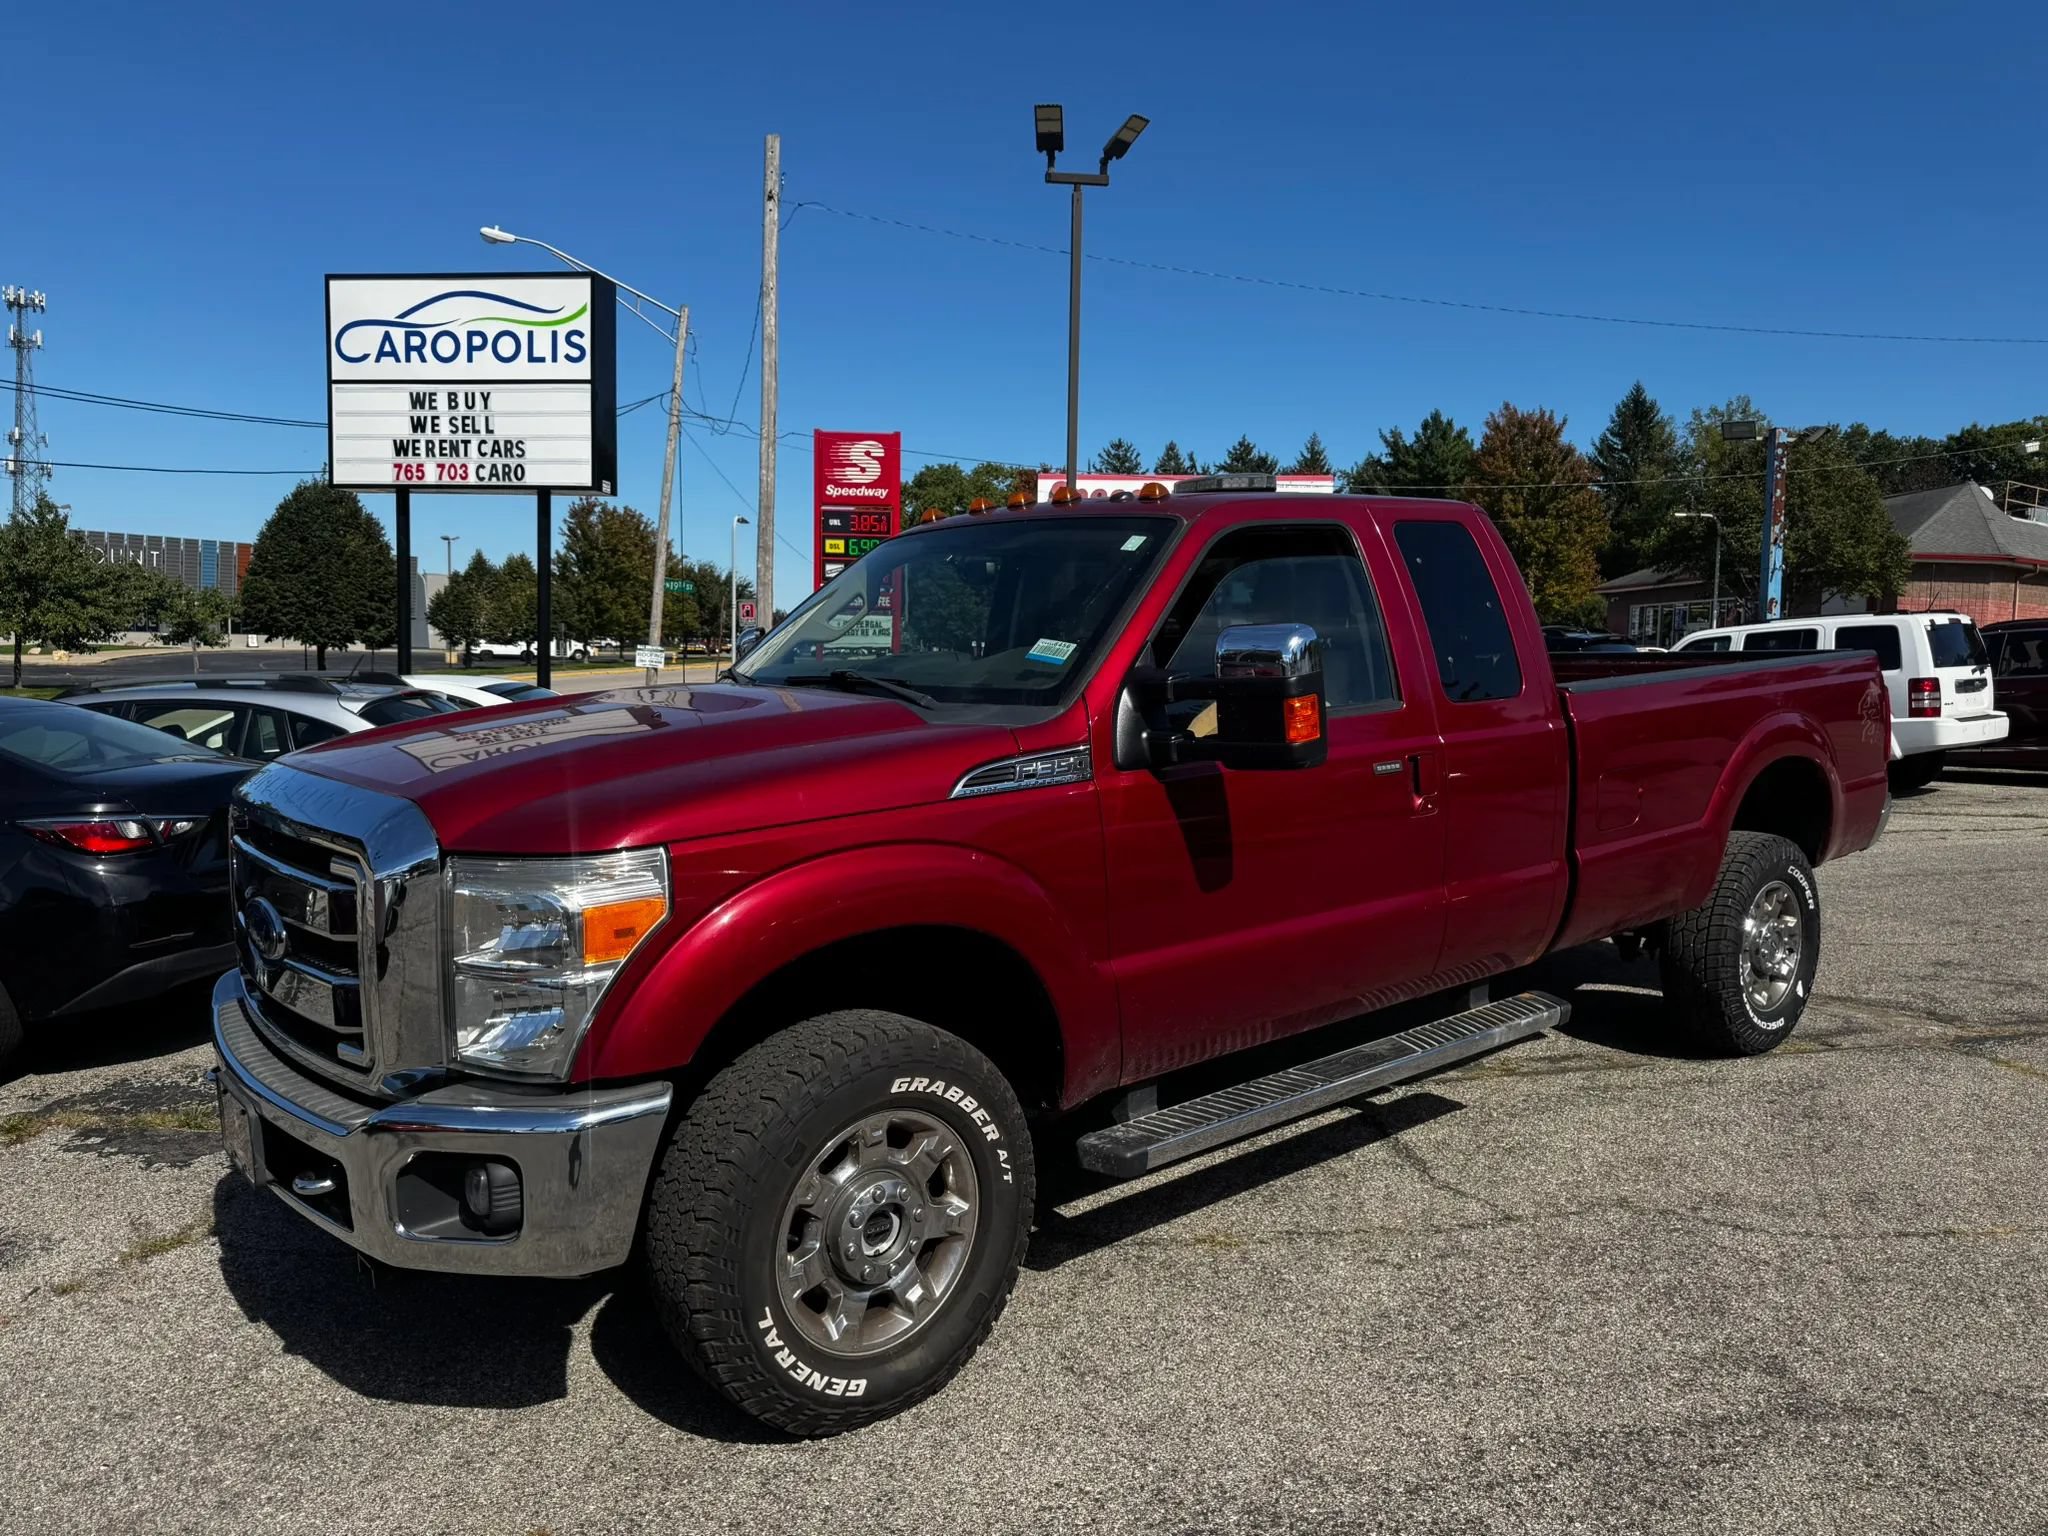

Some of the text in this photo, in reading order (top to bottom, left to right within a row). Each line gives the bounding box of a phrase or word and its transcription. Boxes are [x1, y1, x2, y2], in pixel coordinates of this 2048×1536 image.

[334, 319, 587, 364] CAROPOLIS
[409, 391, 491, 411] WE BUY
[410, 416, 494, 434] WE SELL
[393, 439, 526, 458] WE RENT CARS
[393, 463, 526, 482] 765 703 CARO
[825, 484, 889, 499] Speedway
[829, 518, 842, 526] UNL
[1787, 865, 1815, 910] COOPER
[890, 1077, 1012, 1184] GRABBER A/T
[758, 1306, 868, 1397] GENERAL
